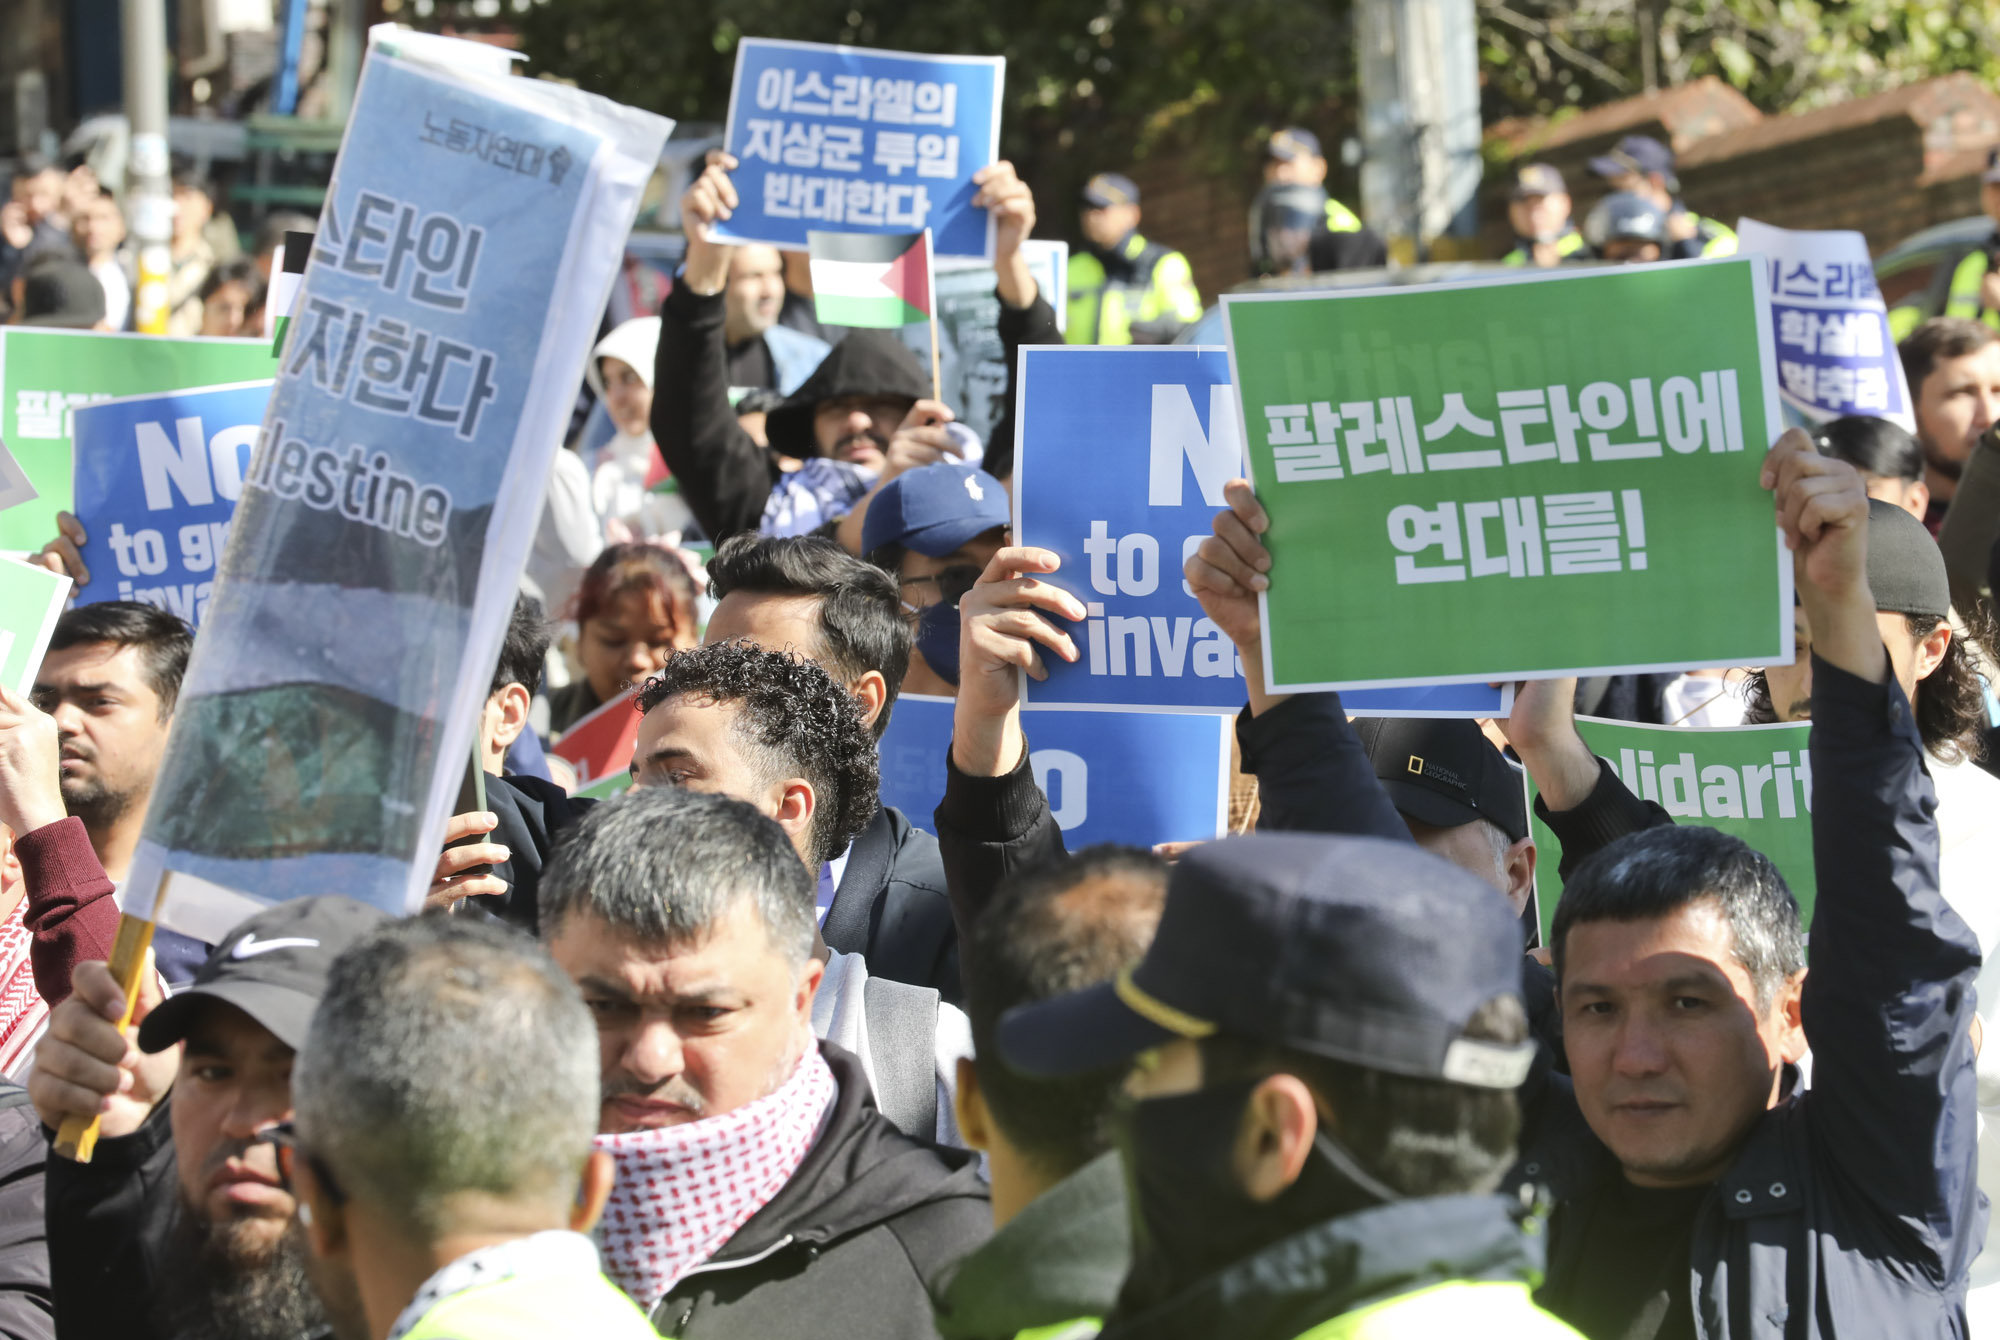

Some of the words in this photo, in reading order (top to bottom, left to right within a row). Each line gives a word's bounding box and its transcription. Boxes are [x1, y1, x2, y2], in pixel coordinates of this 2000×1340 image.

[755, 67, 958, 128] 이스라엘의
[742, 119, 864, 172] 지상군
[873, 130, 960, 179] 투입
[763, 172, 932, 228] 반대한다
[288, 296, 497, 442] 지한다
[1264, 369, 1744, 483] 팔레스타인에
[135, 416, 262, 511] No
[108, 523, 168, 577] to
[1083, 520, 1159, 597] to
[1387, 489, 1648, 585] 연대를!
[1423, 768, 1468, 791] GEOGRAPHIC
[1425, 761, 1459, 780] NATIONAL
